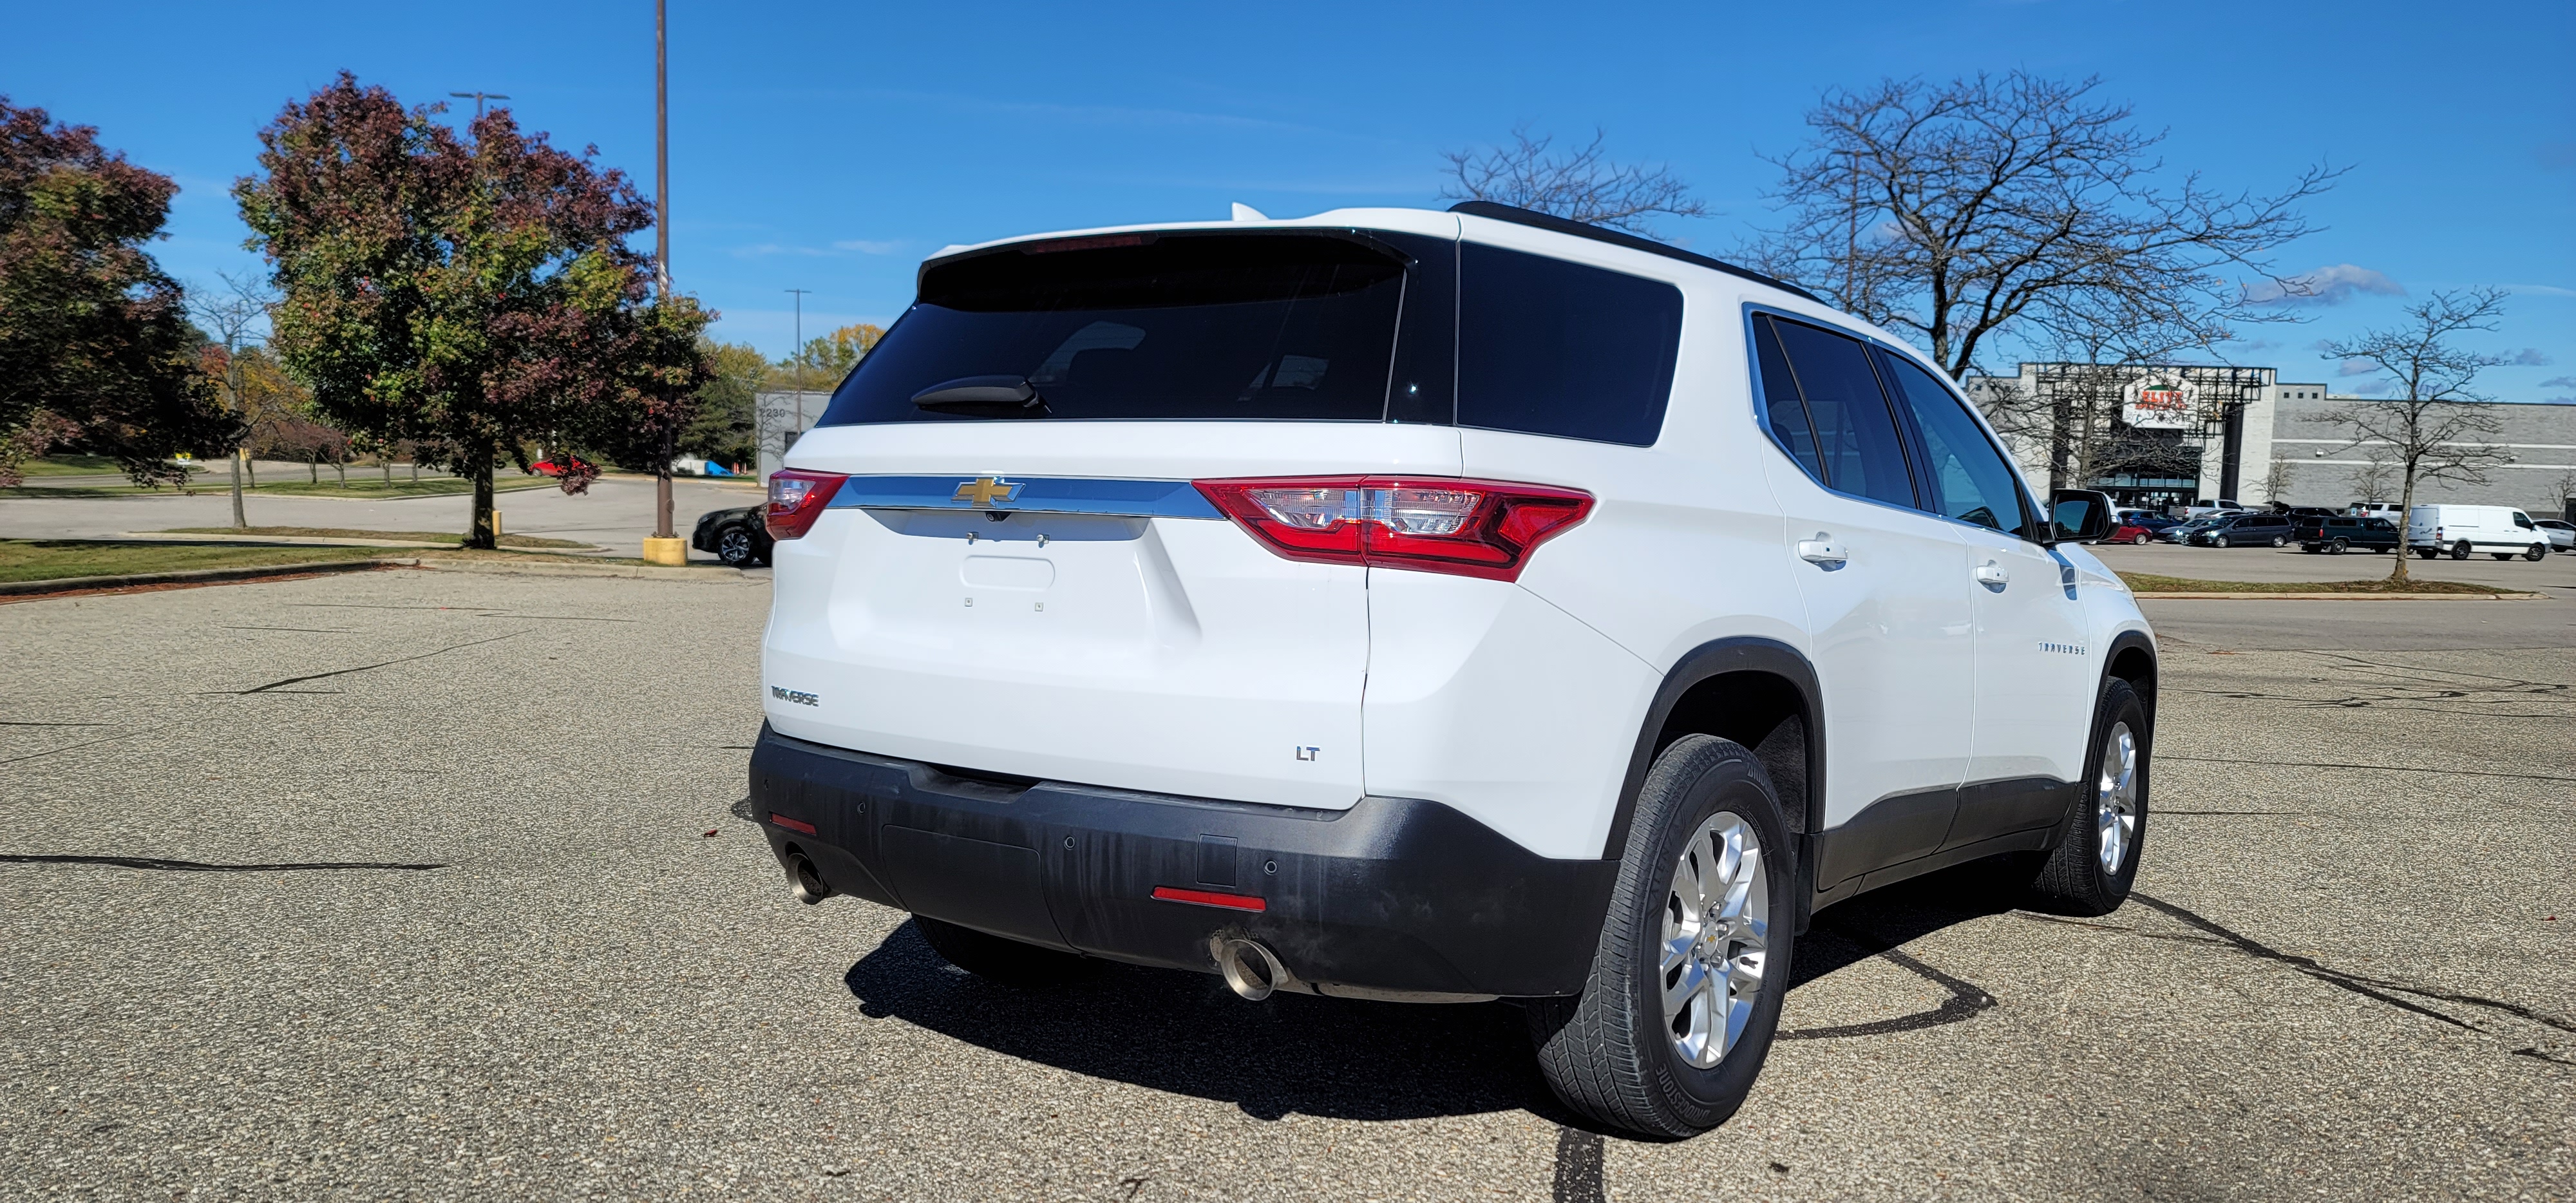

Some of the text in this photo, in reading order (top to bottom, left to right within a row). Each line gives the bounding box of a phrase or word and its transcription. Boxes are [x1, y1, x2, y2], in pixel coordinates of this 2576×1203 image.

[2038, 642, 2085, 656] TRAVERSE
[771, 685, 819, 707] TRAVERSE
[1296, 746, 1321, 762] LT
[1655, 1063, 1710, 1122] BRIDGESTONE
